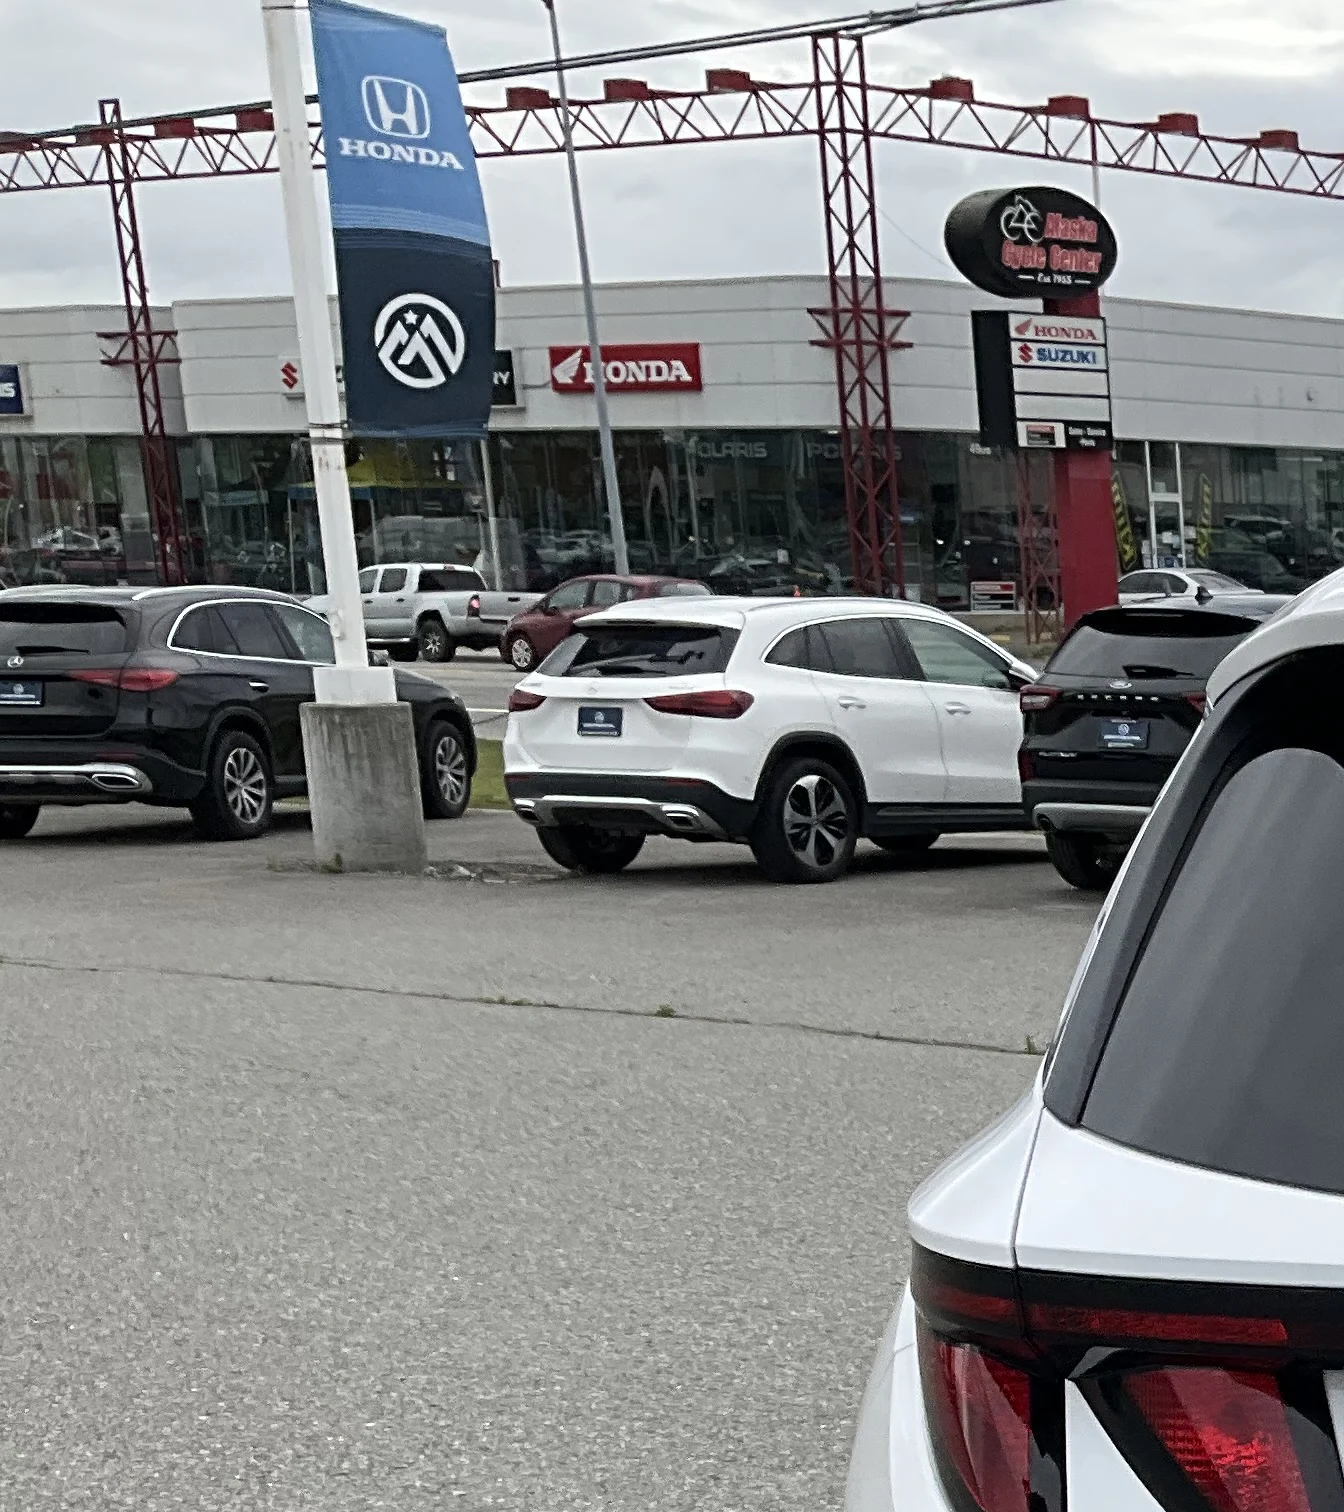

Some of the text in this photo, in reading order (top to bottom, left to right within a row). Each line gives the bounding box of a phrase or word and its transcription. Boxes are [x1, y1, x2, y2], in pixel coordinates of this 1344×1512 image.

[338, 137, 465, 170] HONDA
[1033, 325, 1098, 341] HONDA
[1036, 347, 1097, 364] SUZUKI
